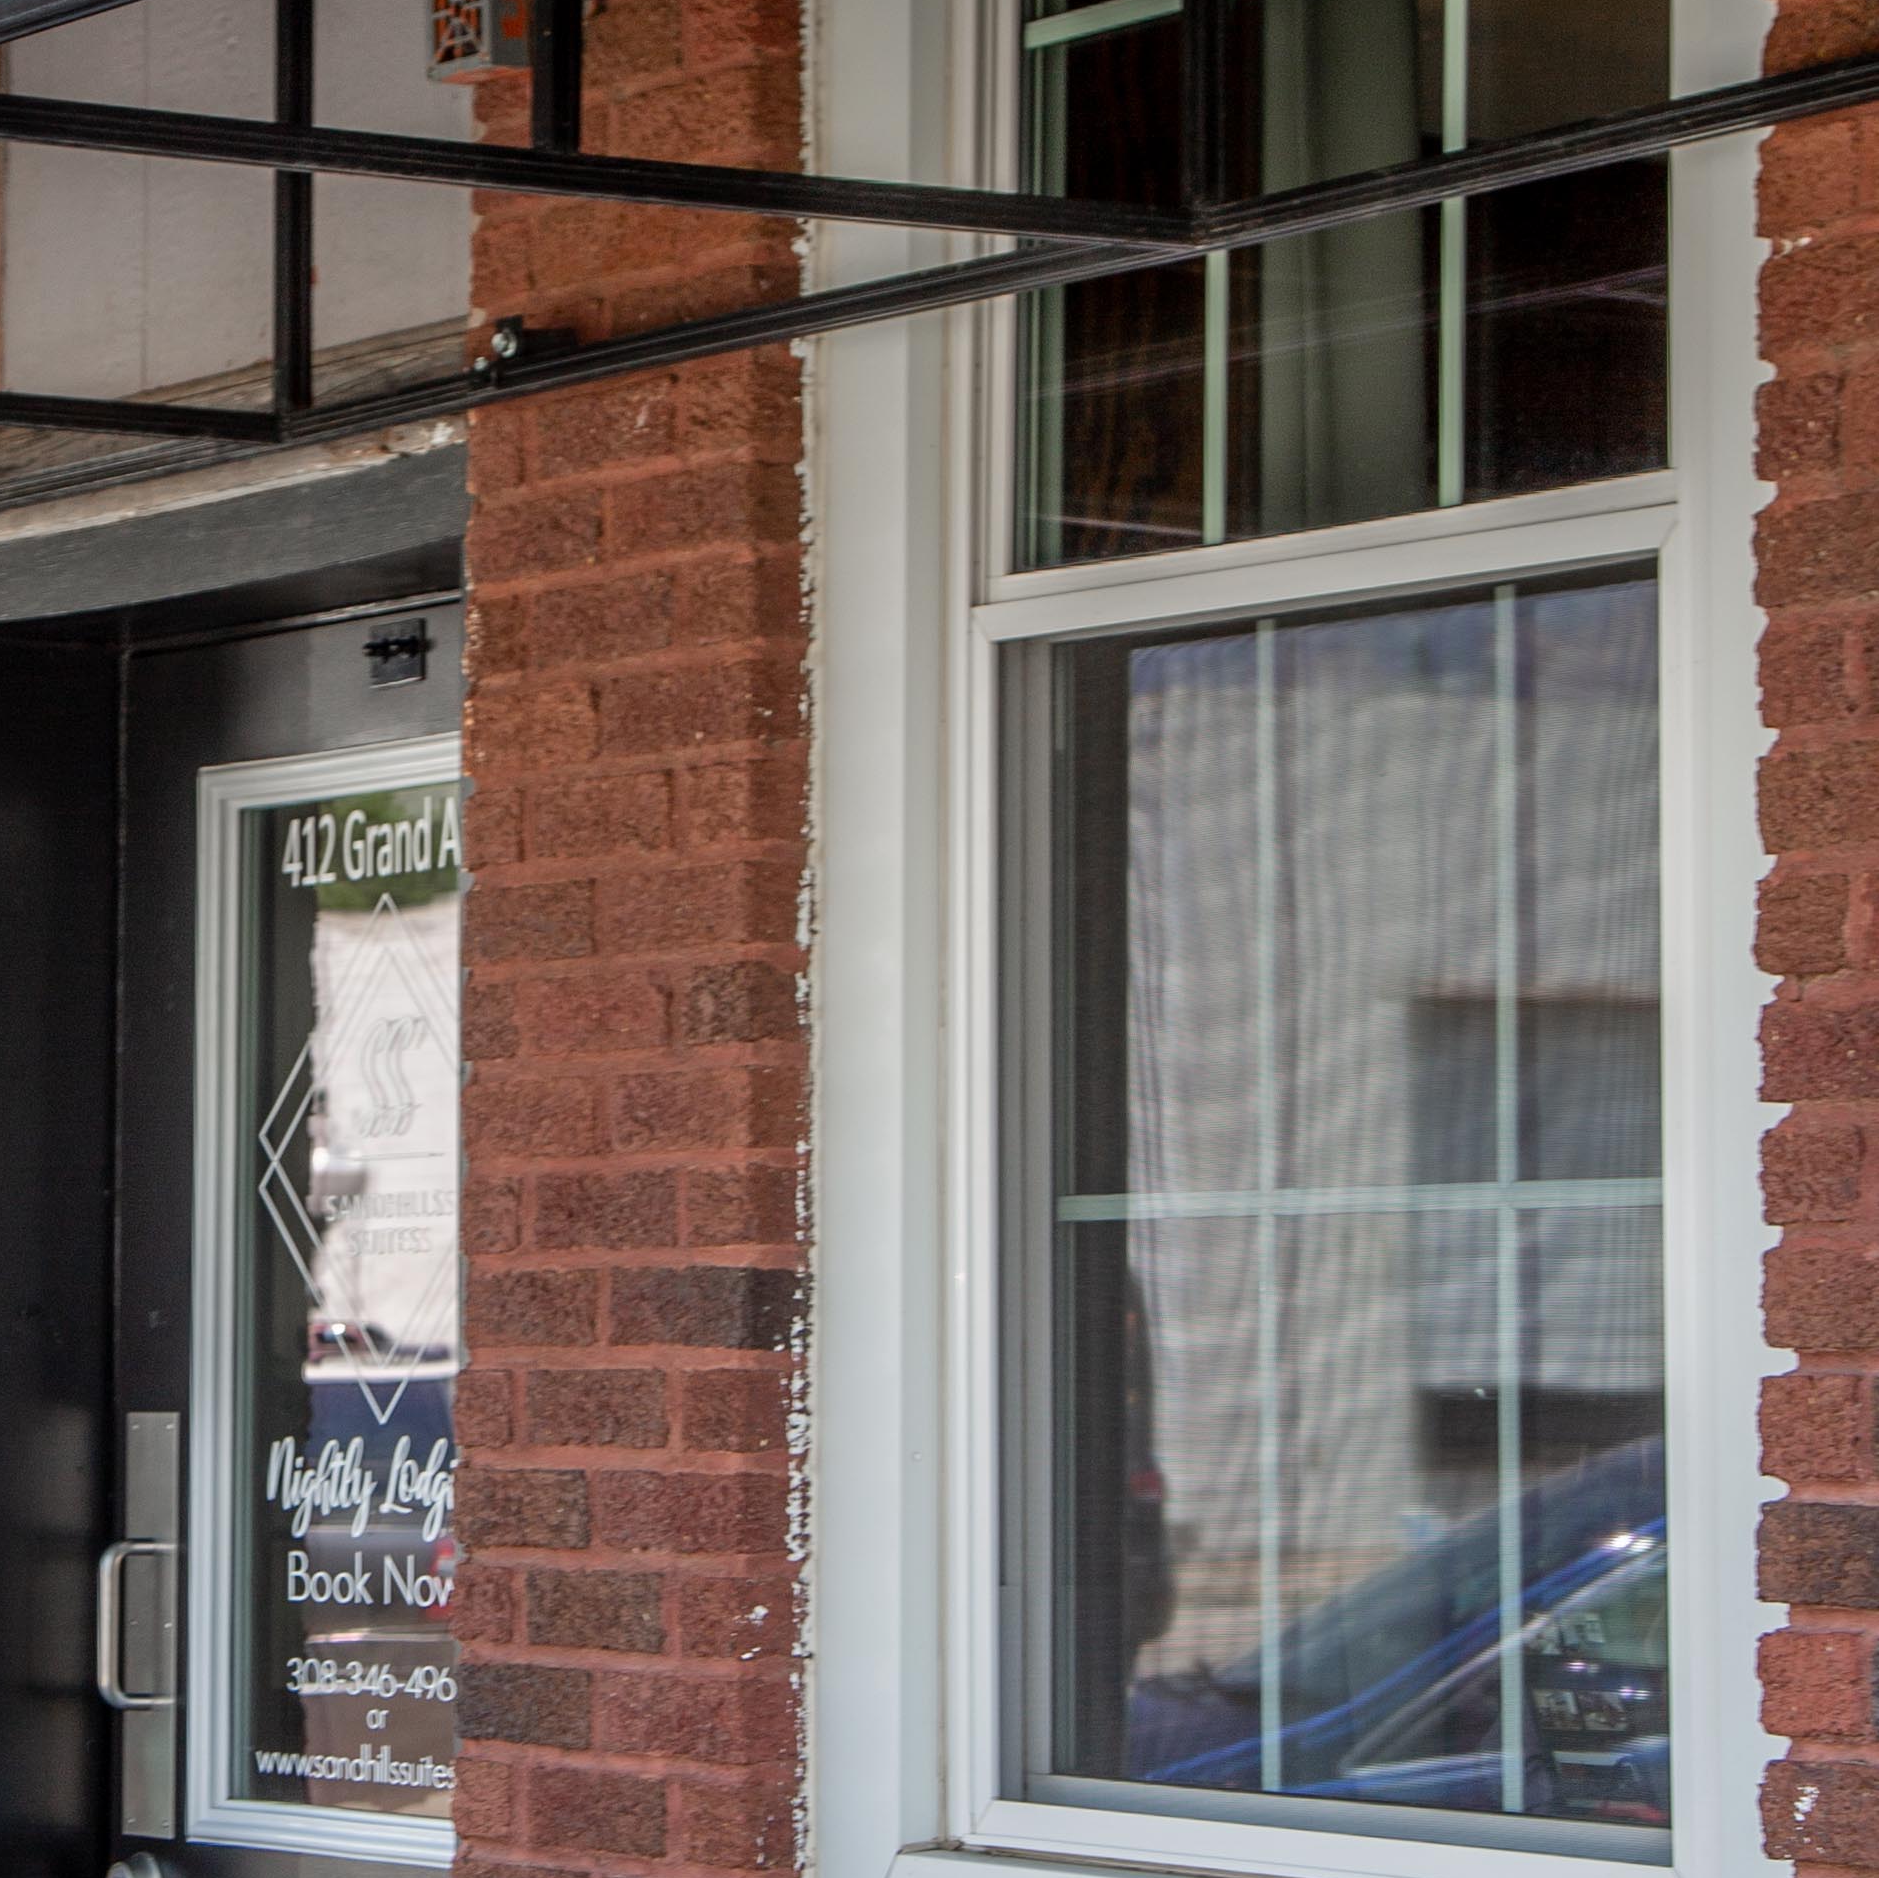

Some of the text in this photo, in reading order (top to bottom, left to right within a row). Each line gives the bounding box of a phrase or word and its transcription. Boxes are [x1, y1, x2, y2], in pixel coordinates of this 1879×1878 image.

[282, 813, 337, 889] 412
[342, 795, 432, 881] Grand
[266, 1435, 378, 1539] Nightly
[287, 1549, 373, 1605] Book
[286, 1657, 458, 1702] 308-346-496
[366, 1709, 390, 1730] or
